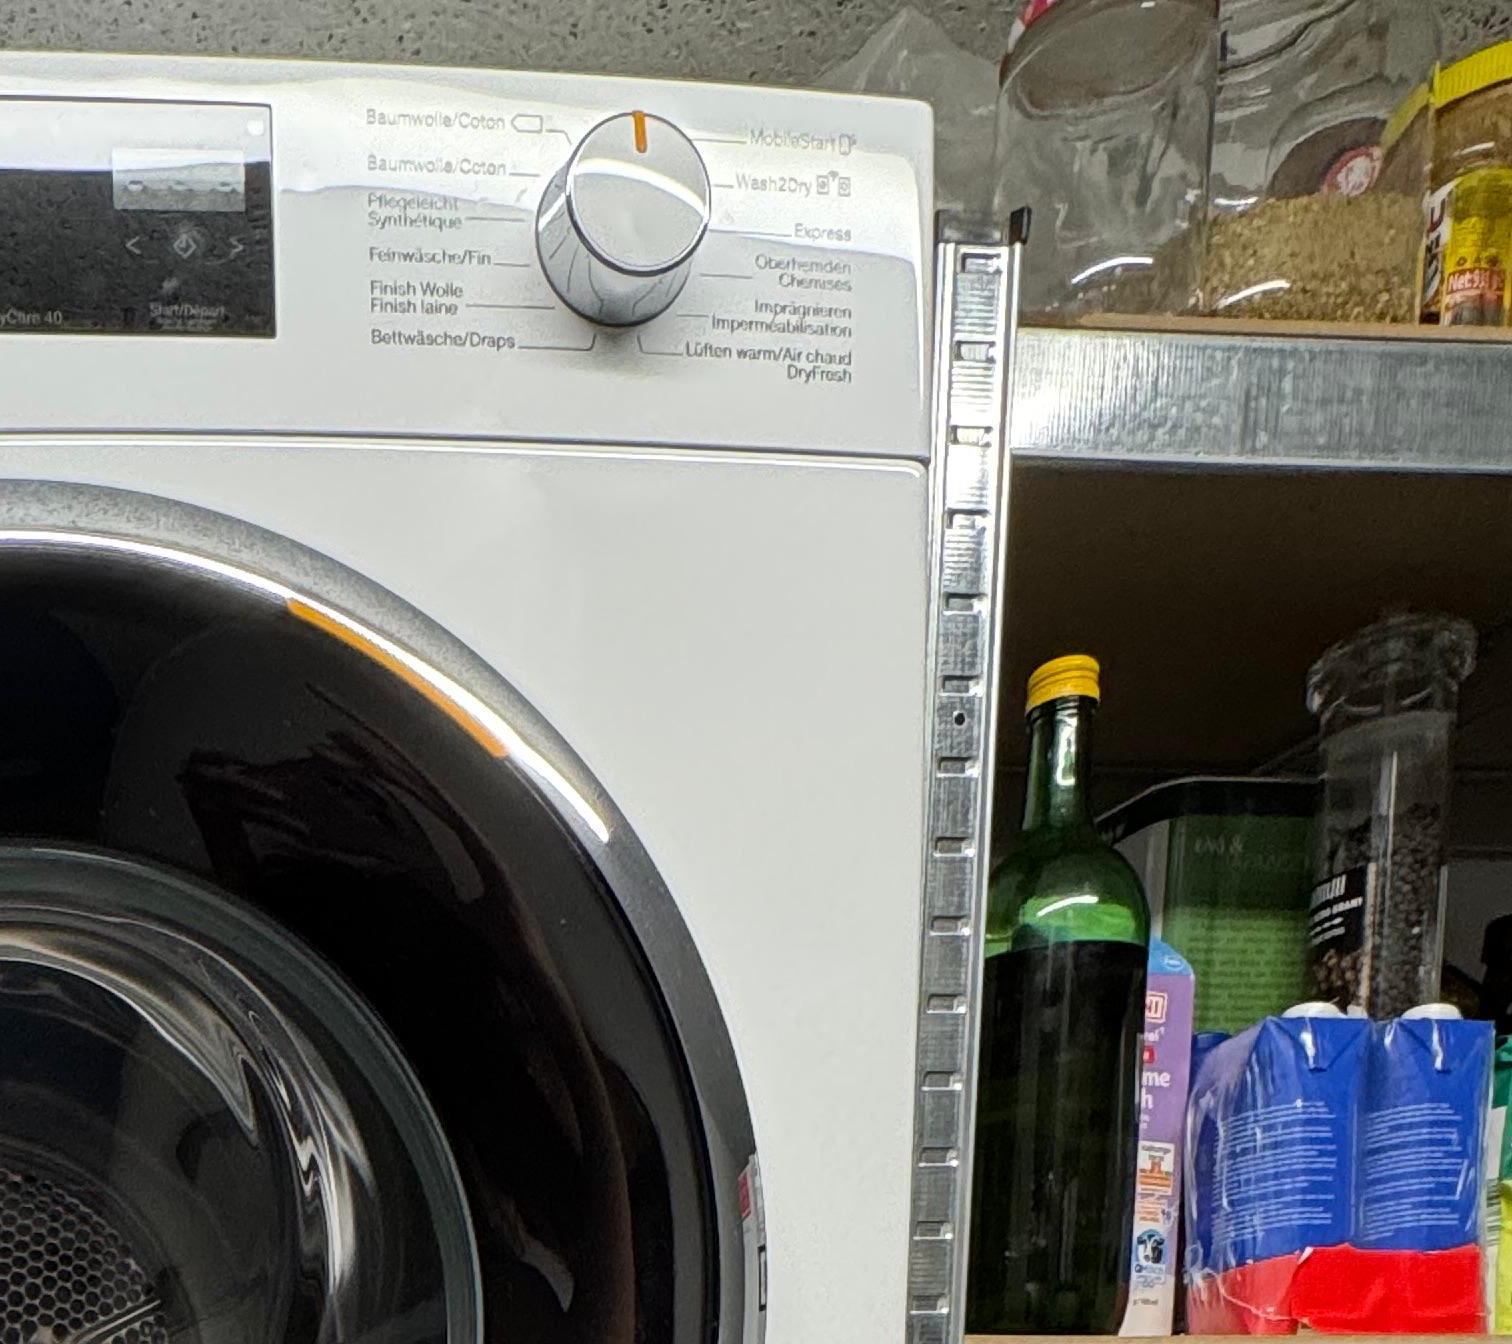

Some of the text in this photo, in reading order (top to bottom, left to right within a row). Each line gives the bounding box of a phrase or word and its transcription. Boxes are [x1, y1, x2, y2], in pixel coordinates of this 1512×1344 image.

[366, 108, 506, 130] Baumwolle/Coton
[749, 128, 836, 151] MobileStart
[367, 154, 506, 176] Baumwolle/Coton
[736, 171, 813, 198] Wash2Dry
[367, 192, 460, 213] Pflegeleicht
[367, 210, 463, 231] Synthétique
[794, 222, 853, 243] Express
[369, 246, 492, 266] Feinwäsche/Fin
[754, 253, 852, 275] Oberhemden
[370, 280, 464, 298] Finish Wolle
[778, 272, 853, 293] Chemises
[370, 297, 458, 315] Finish laine
[754, 299, 852, 321] Imprägnieren
[44, 310, 63, 325] 40
[370, 328, 516, 351] Bettwäsche/Draps
[685, 341, 852, 366] Lüften warm/Air chaud
[787, 364, 852, 384] DryFresh
